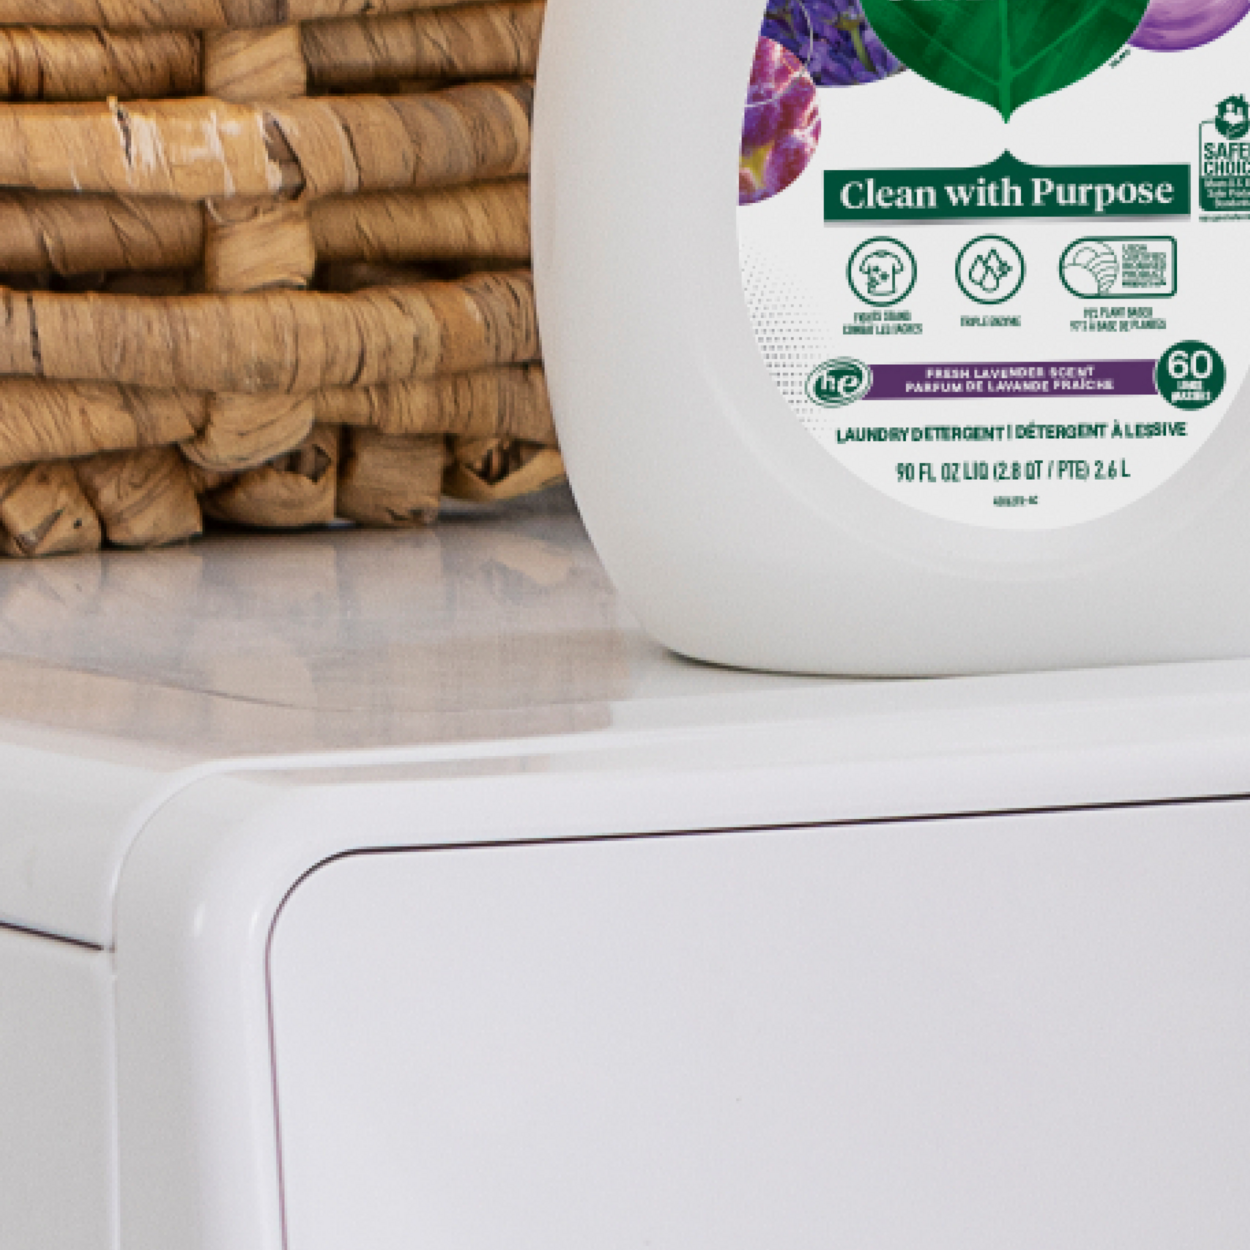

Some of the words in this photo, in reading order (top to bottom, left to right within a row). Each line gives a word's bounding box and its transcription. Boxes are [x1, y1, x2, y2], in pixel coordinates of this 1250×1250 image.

[840, 178, 938, 209] Clean
[944, 176, 1022, 207] with
[1030, 177, 1175, 212] Purpose
[925, 367, 970, 379] FRESH
[973, 366, 1046, 379] LAVENDER
[1049, 364, 1096, 378] SCENT
[1168, 350, 1213, 379] 60
[905, 381, 964, 393] PARFUM
[966, 380, 984, 393] DE
[987, 380, 1050, 393] LAVANDE
[835, 426, 909, 444] LAUNDRY
[911, 425, 1005, 442] DETERGENT
[1015, 419, 1108, 439] DÉTERGENT
[1125, 422, 1188, 439] LESSIVE
[896, 462, 915, 482] 90
[941, 462, 961, 482] OZ
[1094, 460, 1118, 480] 2.6
[1121, 458, 1131, 477] L
